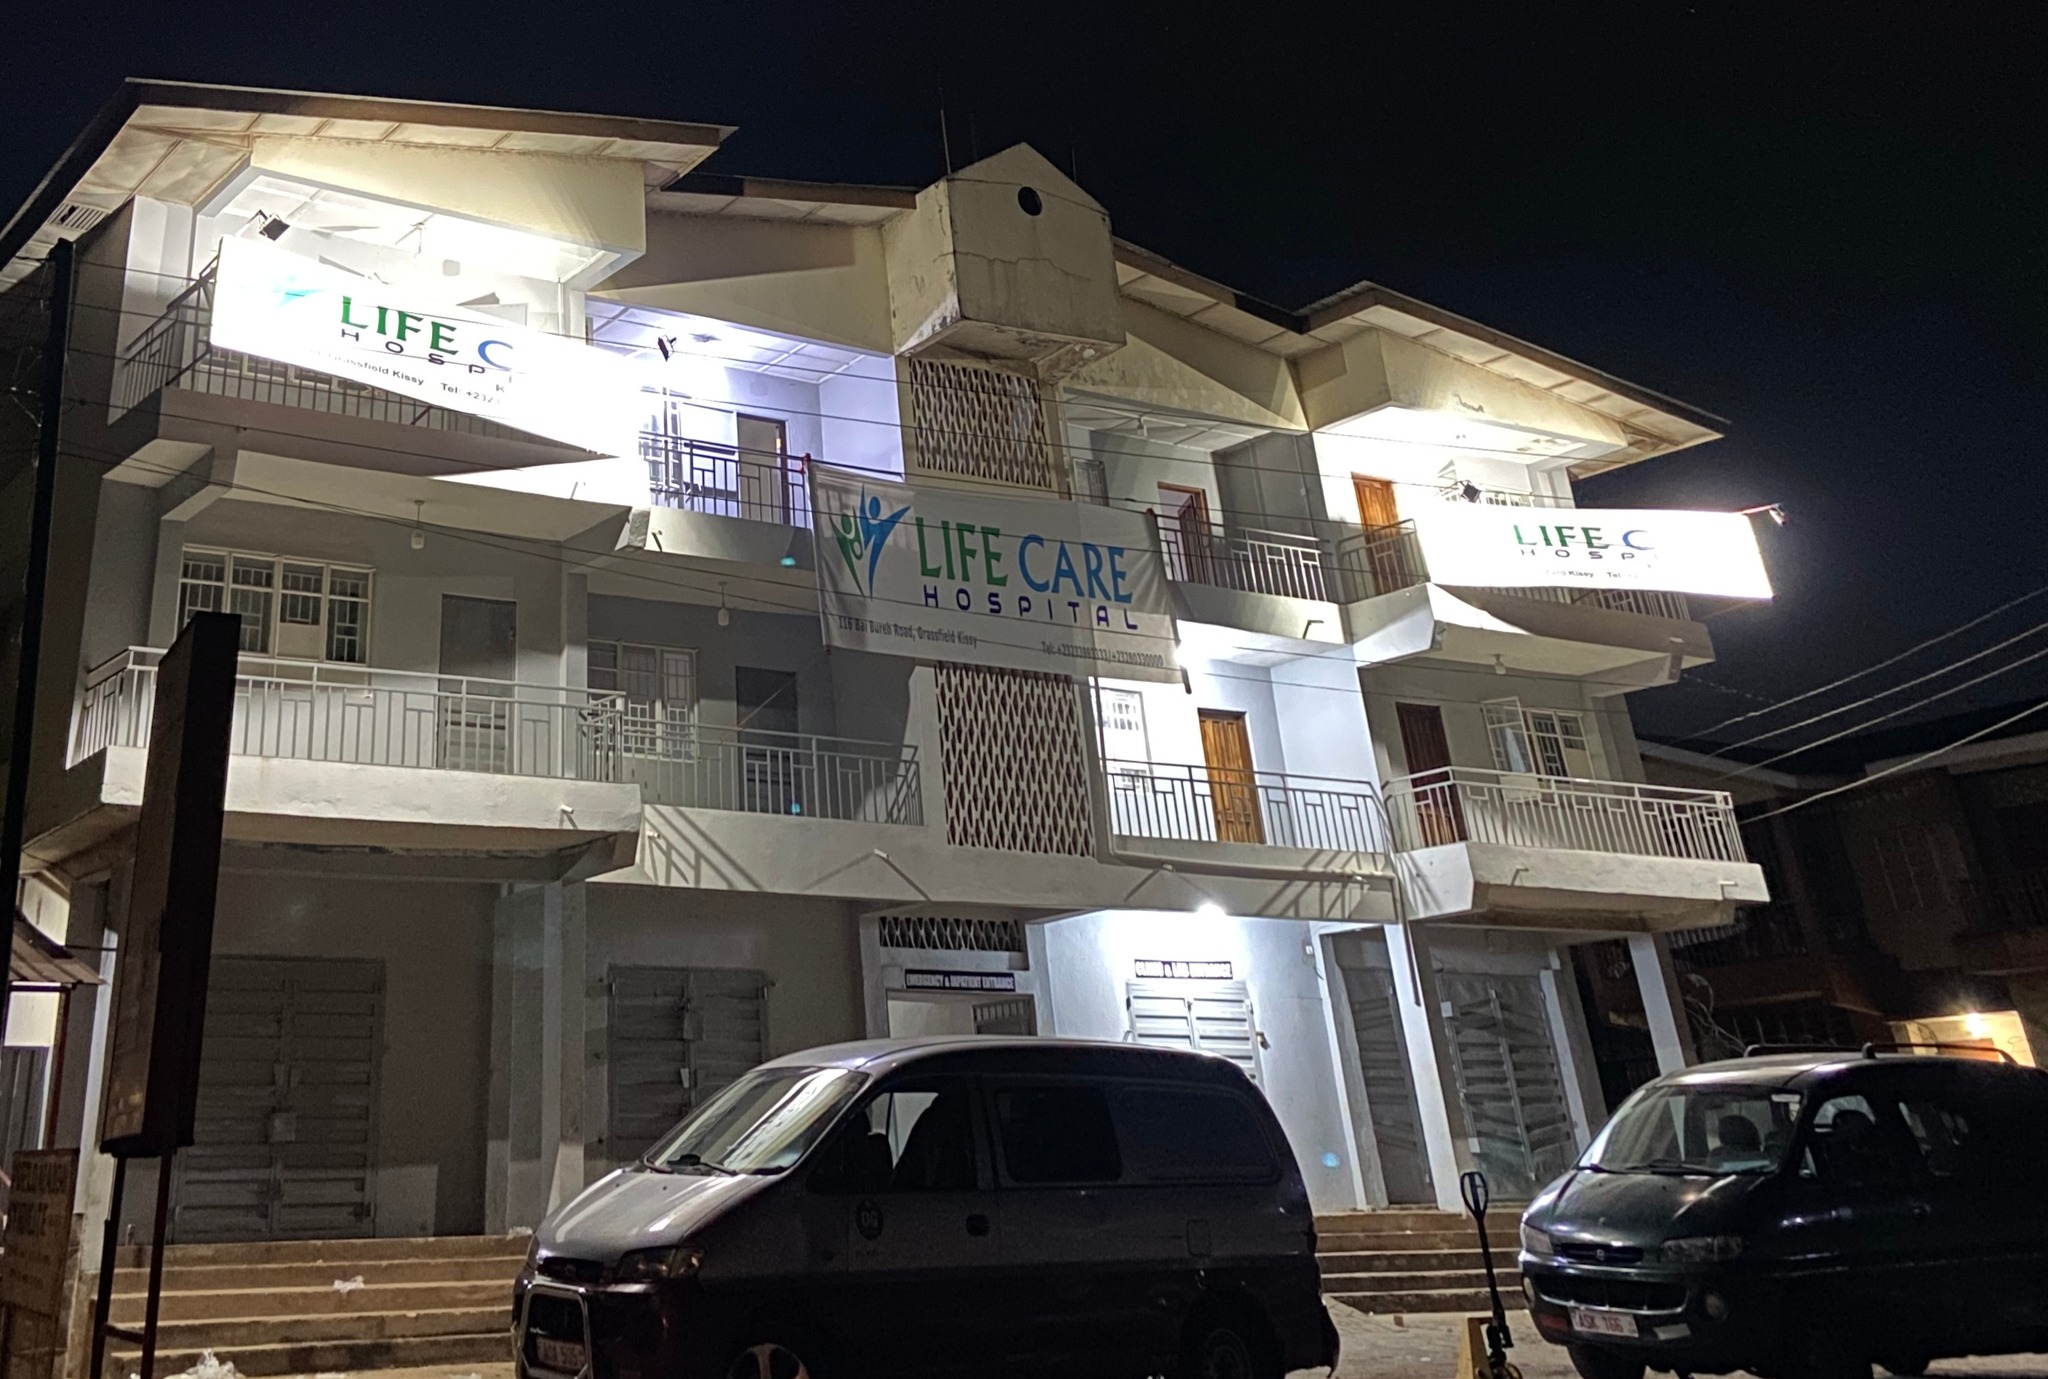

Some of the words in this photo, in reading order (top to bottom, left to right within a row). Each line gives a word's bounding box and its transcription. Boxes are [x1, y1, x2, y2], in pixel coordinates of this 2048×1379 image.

[340, 295, 459, 356] LIFE
[341, 328, 513, 384] HOSPI
[392, 369, 425, 386] Kissy
[1513, 524, 1609, 549] LIFE
[1520, 548, 1636, 561] HOSP
[915, 516, 1008, 587] LIFE
[1018, 533, 1133, 604] CARE
[923, 584, 1138, 630] HOSPITAL
[869, 619, 892, 635] Bureh
[894, 623, 916, 641] Road,
[917, 626, 956, 644] Grassfield
[956, 630, 977, 648] Kissy
